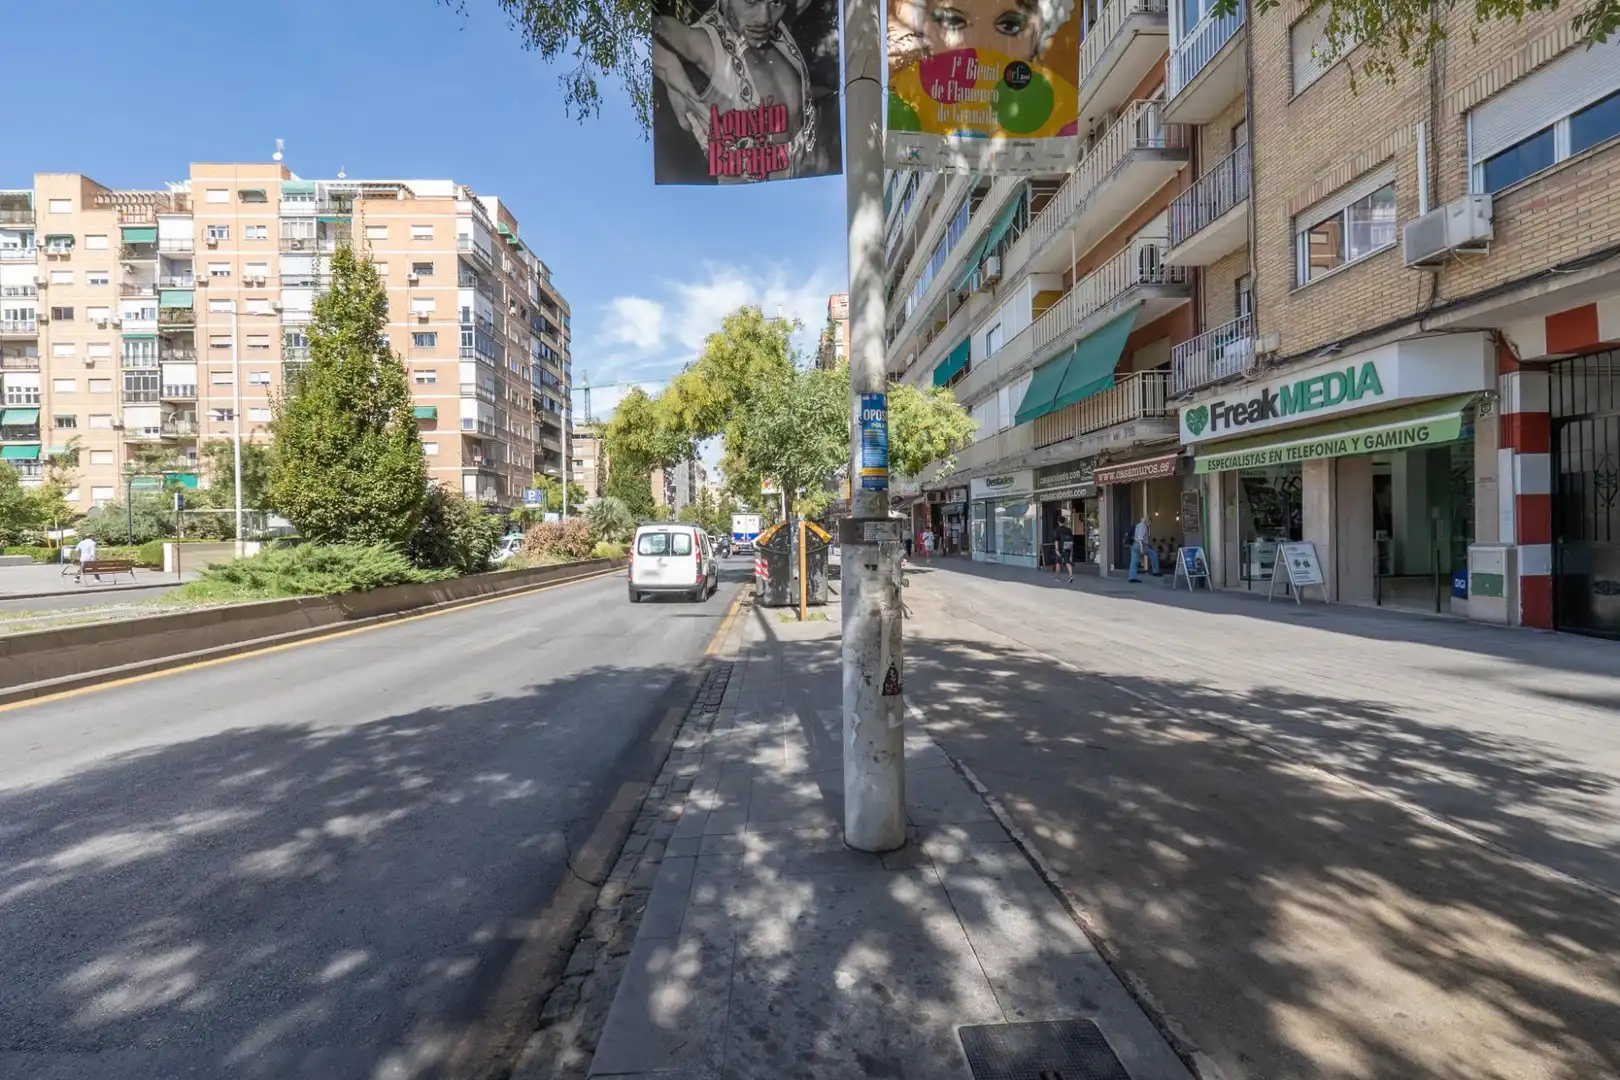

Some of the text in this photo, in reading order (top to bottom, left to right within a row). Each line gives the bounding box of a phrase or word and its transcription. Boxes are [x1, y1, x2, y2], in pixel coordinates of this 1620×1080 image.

[965, 56, 999, 81] Bienal
[931, 79, 999, 103] de Flamenco
[709, 95, 788, 147] Agustín
[937, 103, 999, 125] de Granada
[708, 141, 789, 180] Barajas
[1210, 361, 1384, 432] FreakMEDIA
[1207, 426, 1430, 471] ESPECIALISTAS EN TELEFONIA Y GAMING
[528, 490, 536, 501] P
[1454, 578, 1466, 589] DIGI
